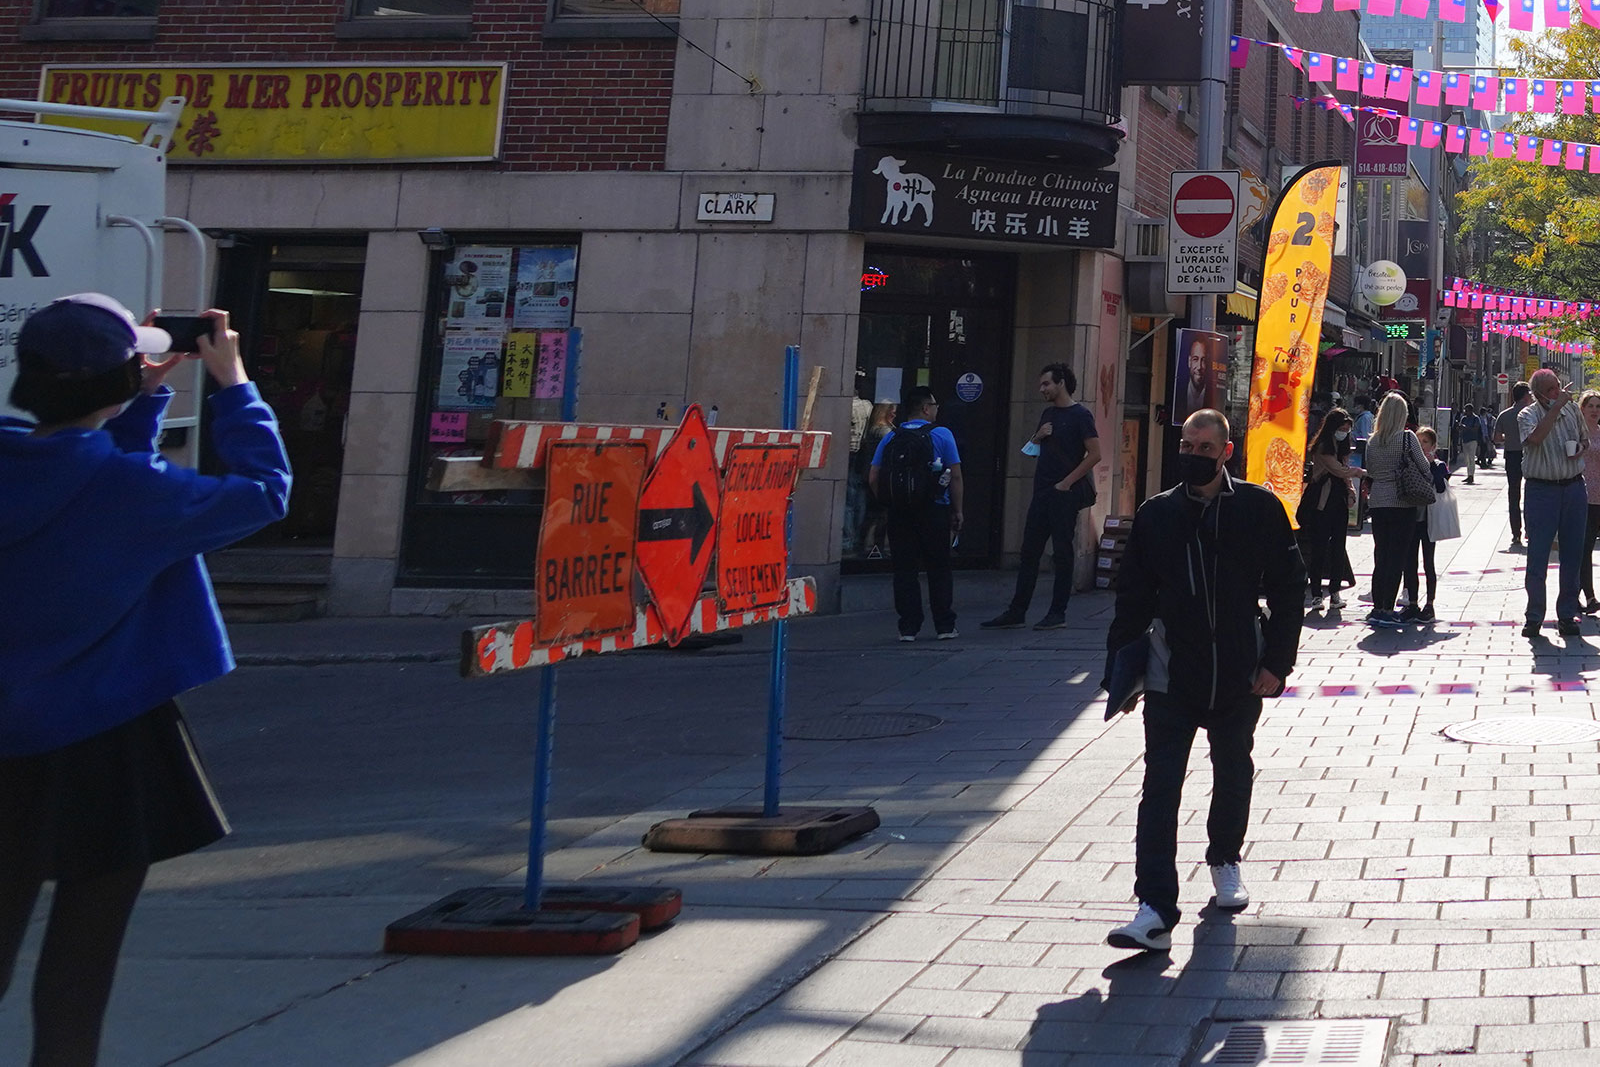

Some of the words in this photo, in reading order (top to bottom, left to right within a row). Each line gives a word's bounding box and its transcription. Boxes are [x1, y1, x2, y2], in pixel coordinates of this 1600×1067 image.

[49, 73, 161, 107] FRUITS
[175, 74, 213, 108] DE
[224, 74, 290, 109] MER
[302, 71, 498, 108] PROSPERITY
[942, 163, 965, 180] La
[972, 166, 1037, 188] Fondue
[1042, 172, 1114, 195] Chinoise
[705, 200, 756, 214] CLARK
[955, 184, 1020, 206] Agneau
[1027, 190, 1100, 211] Heureux
[971, 209, 1090, 240] 快乐小羊
[1291, 211, 1315, 246] 2
[1180, 243, 1224, 253] EXCEPTÉ
[1177, 275, 1190, 283] DE
[1193, 275, 1205, 283] 6h
[1213, 275, 1225, 283] 11h
[1386, 284, 1403, 292] perles
[1290, 268, 1302, 323] POUR
[727, 461, 795, 491] CIRCULATION
[570, 482, 612, 525] RUE
[736, 510, 772, 543] LOCALE
[546, 544, 627, 602] BARRÉE
[726, 562, 781, 598] SEULEMENT
